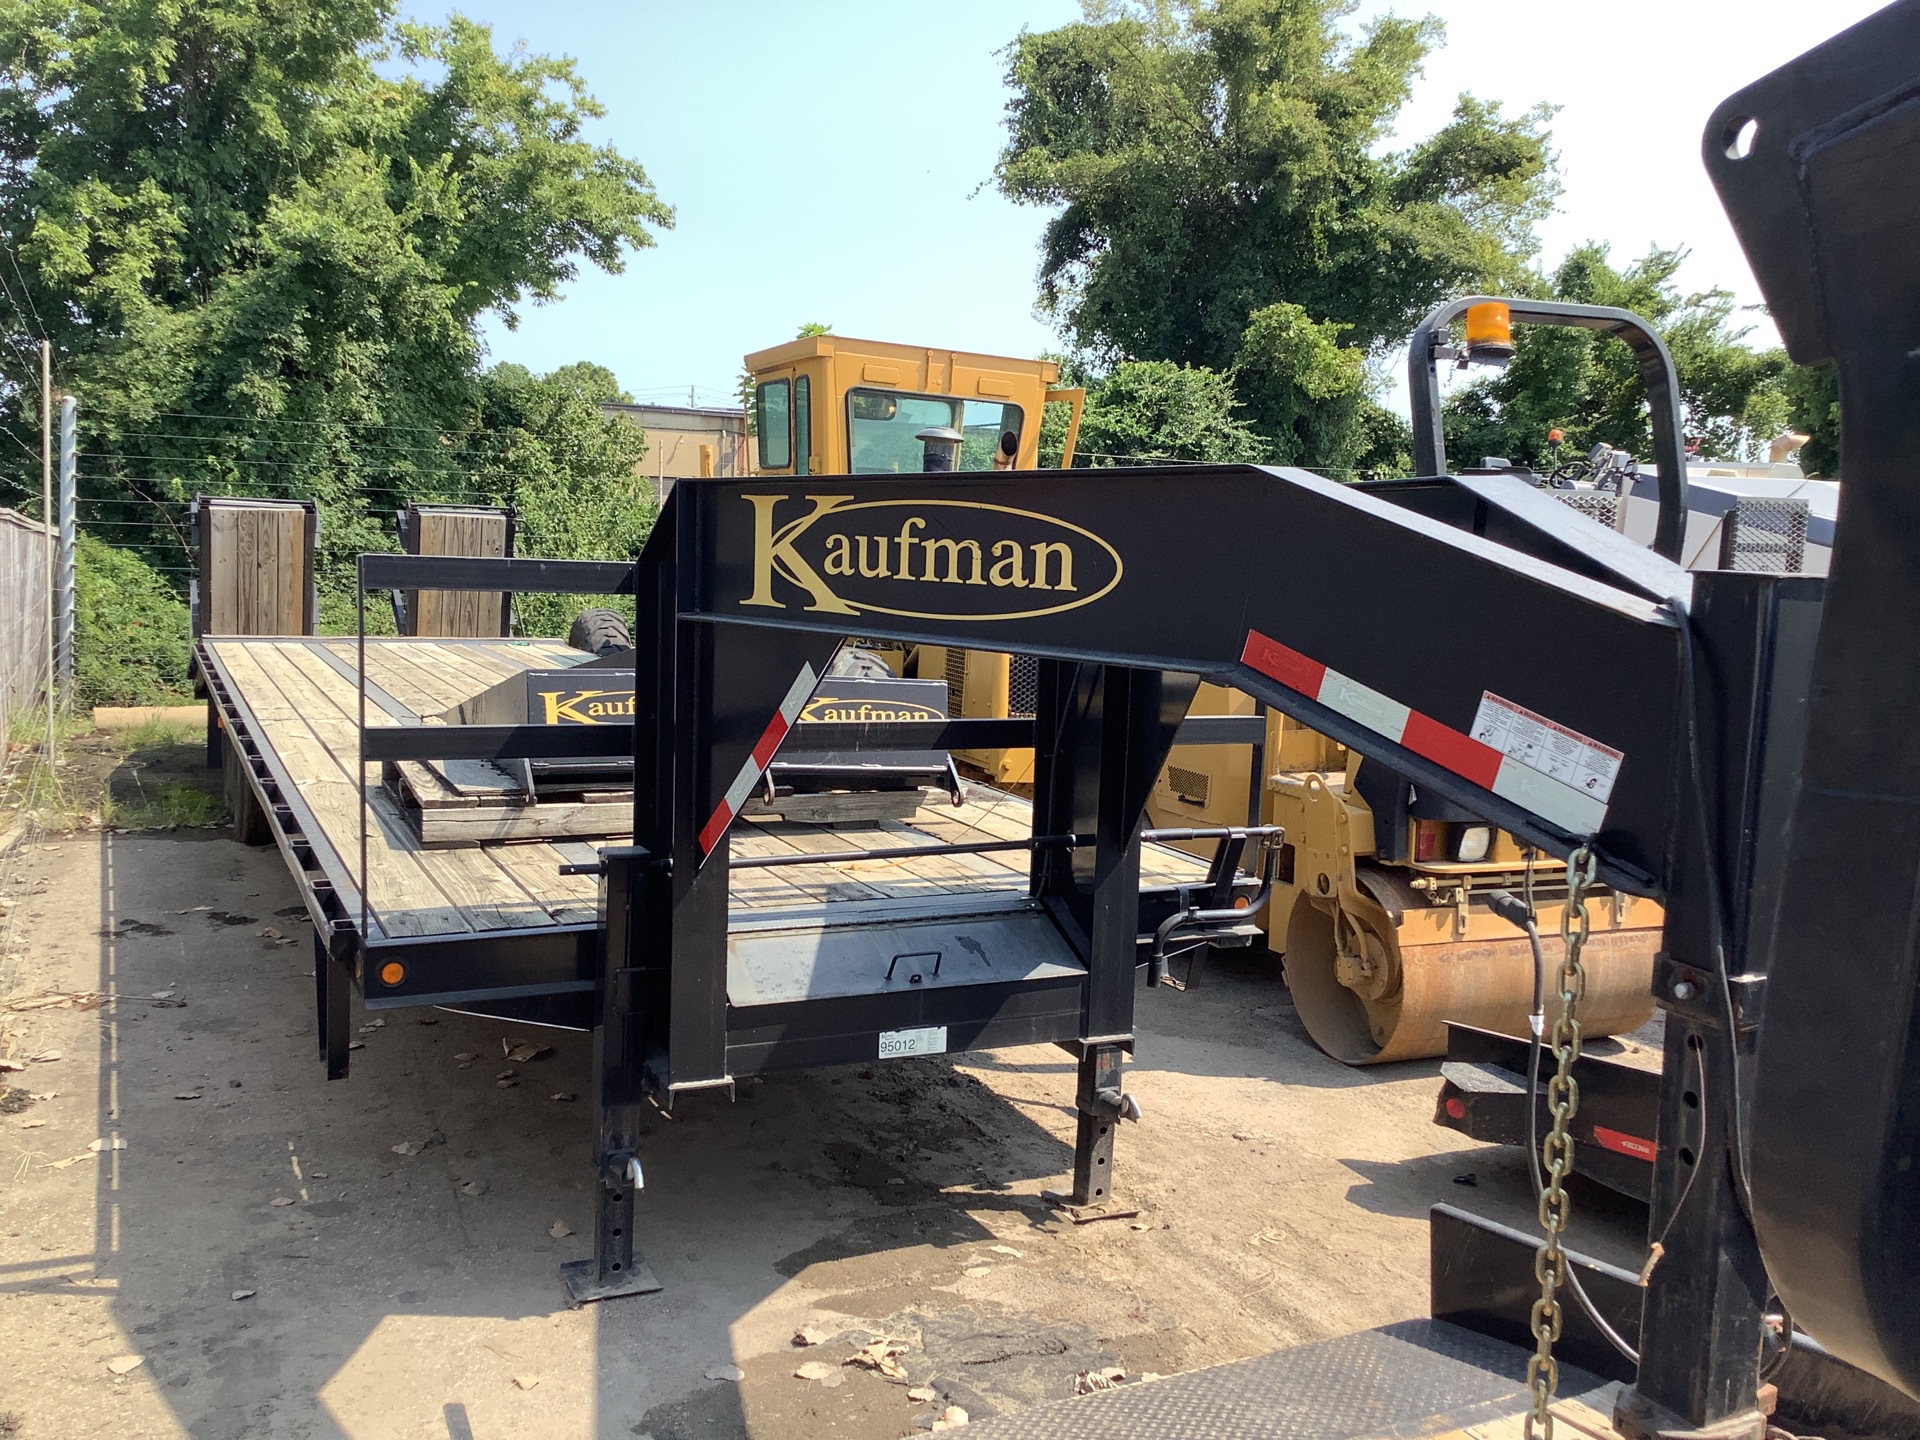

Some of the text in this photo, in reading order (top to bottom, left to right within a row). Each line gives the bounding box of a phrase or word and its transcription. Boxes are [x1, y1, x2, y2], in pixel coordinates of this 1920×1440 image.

[739, 494, 1078, 616] Kaufman
[537, 690, 636, 725] Kauf
[880, 1038, 916, 1053] 95012
